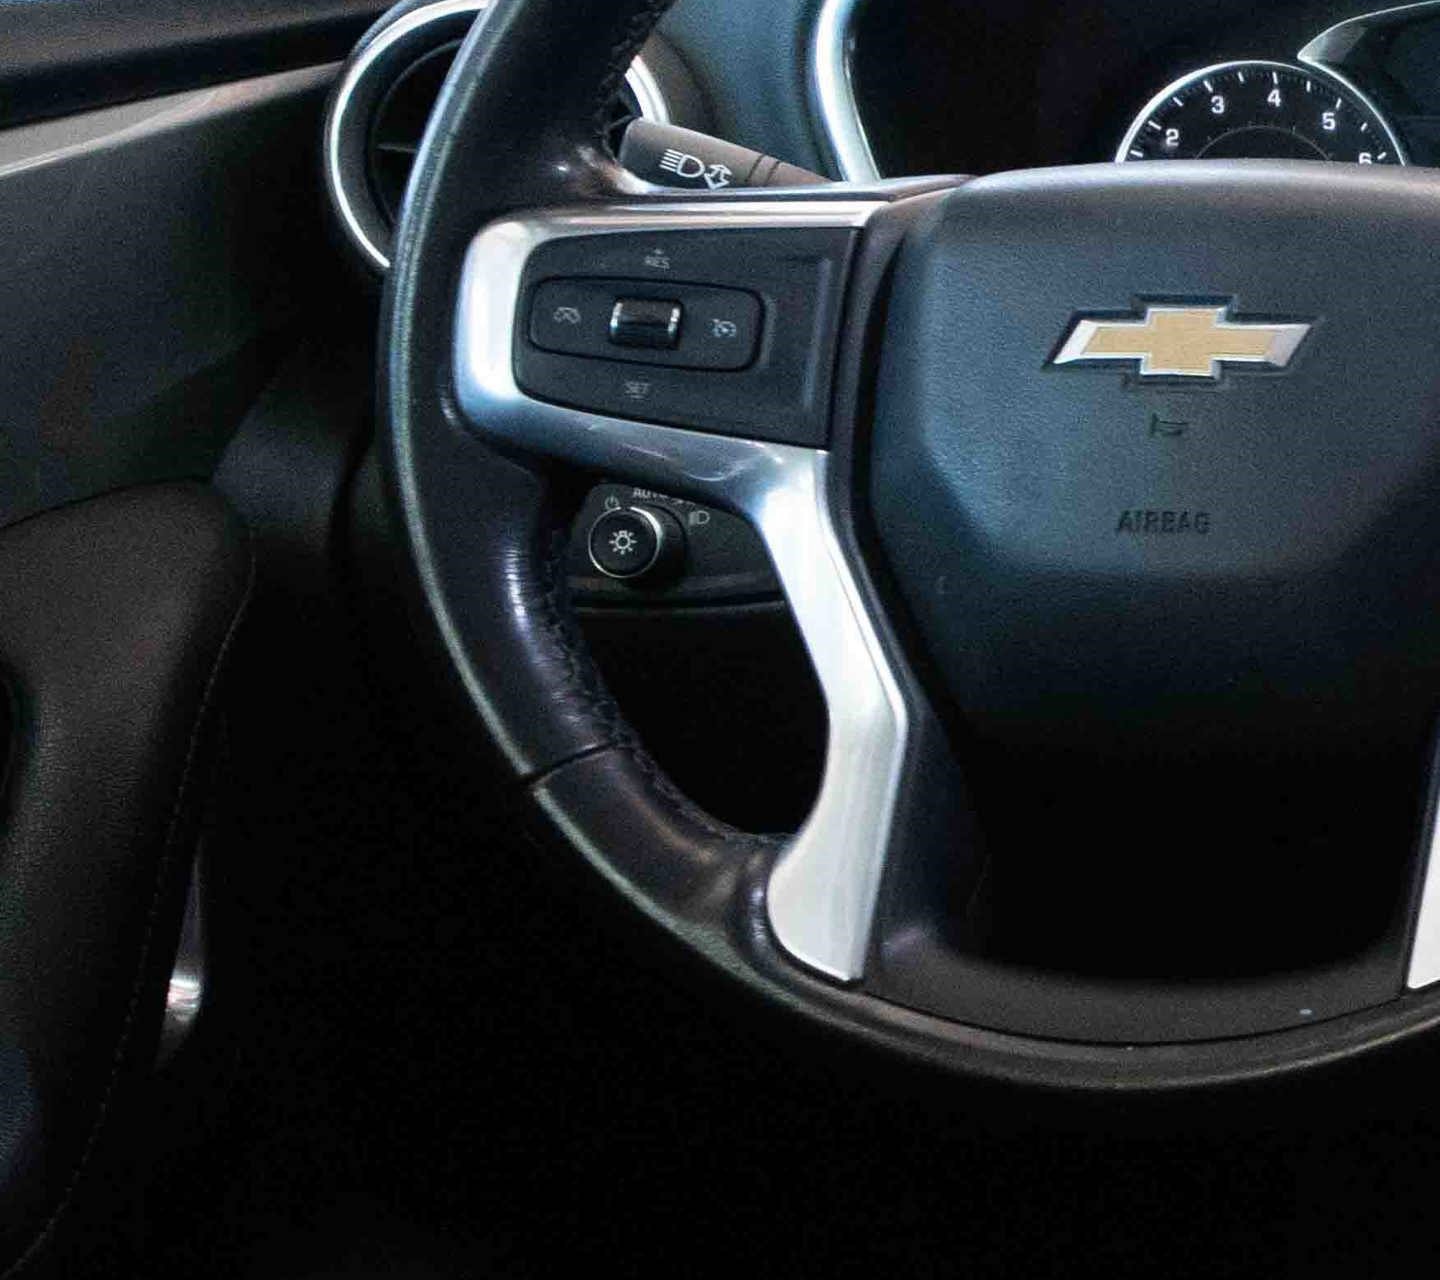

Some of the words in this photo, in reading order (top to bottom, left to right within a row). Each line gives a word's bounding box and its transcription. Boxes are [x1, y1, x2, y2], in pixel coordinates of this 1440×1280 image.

[1211, 95, 1225, 114] 3
[1267, 89, 1281, 107] 4
[1321, 111, 1336, 130] 5
[1165, 128, 1179, 147] 2
[1118, 510, 1212, 534] AIRBAG
